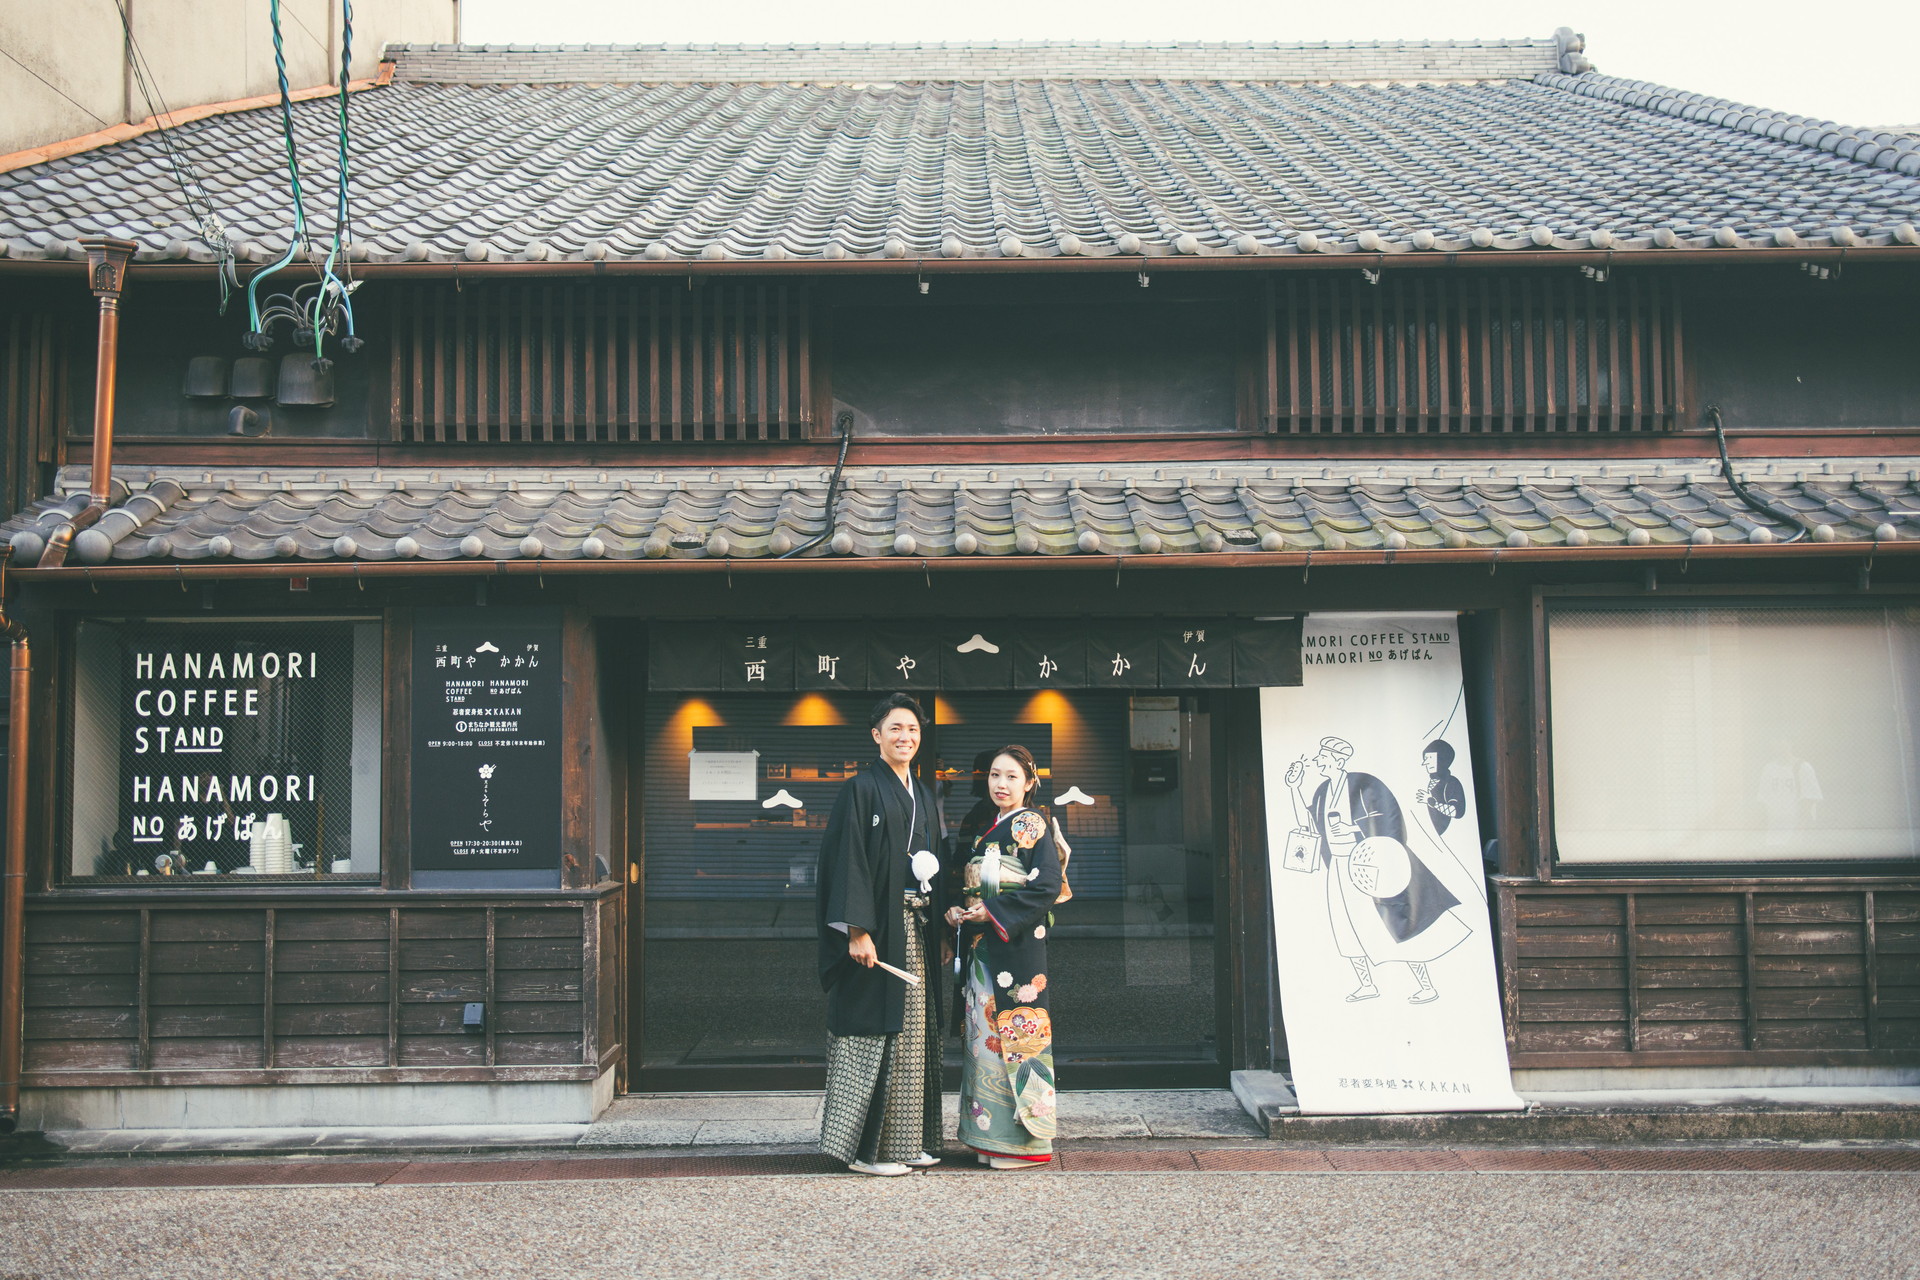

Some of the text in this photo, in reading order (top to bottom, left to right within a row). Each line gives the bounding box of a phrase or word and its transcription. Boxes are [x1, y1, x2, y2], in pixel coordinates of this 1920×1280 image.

[745, 630, 1204, 648] 三重 伊賀
[1301, 633, 1449, 648] MORI COFFEE STAND
[137, 653, 315, 679] HANAMORI
[1369, 651, 1382, 662] NO
[136, 690, 258, 716] COFFEE
[136, 727, 223, 753] STAND
[134, 775, 314, 803] HANAMORI
[133, 813, 282, 842] NO あげぱん
[1417, 1080, 1471, 1094] KAKAN
